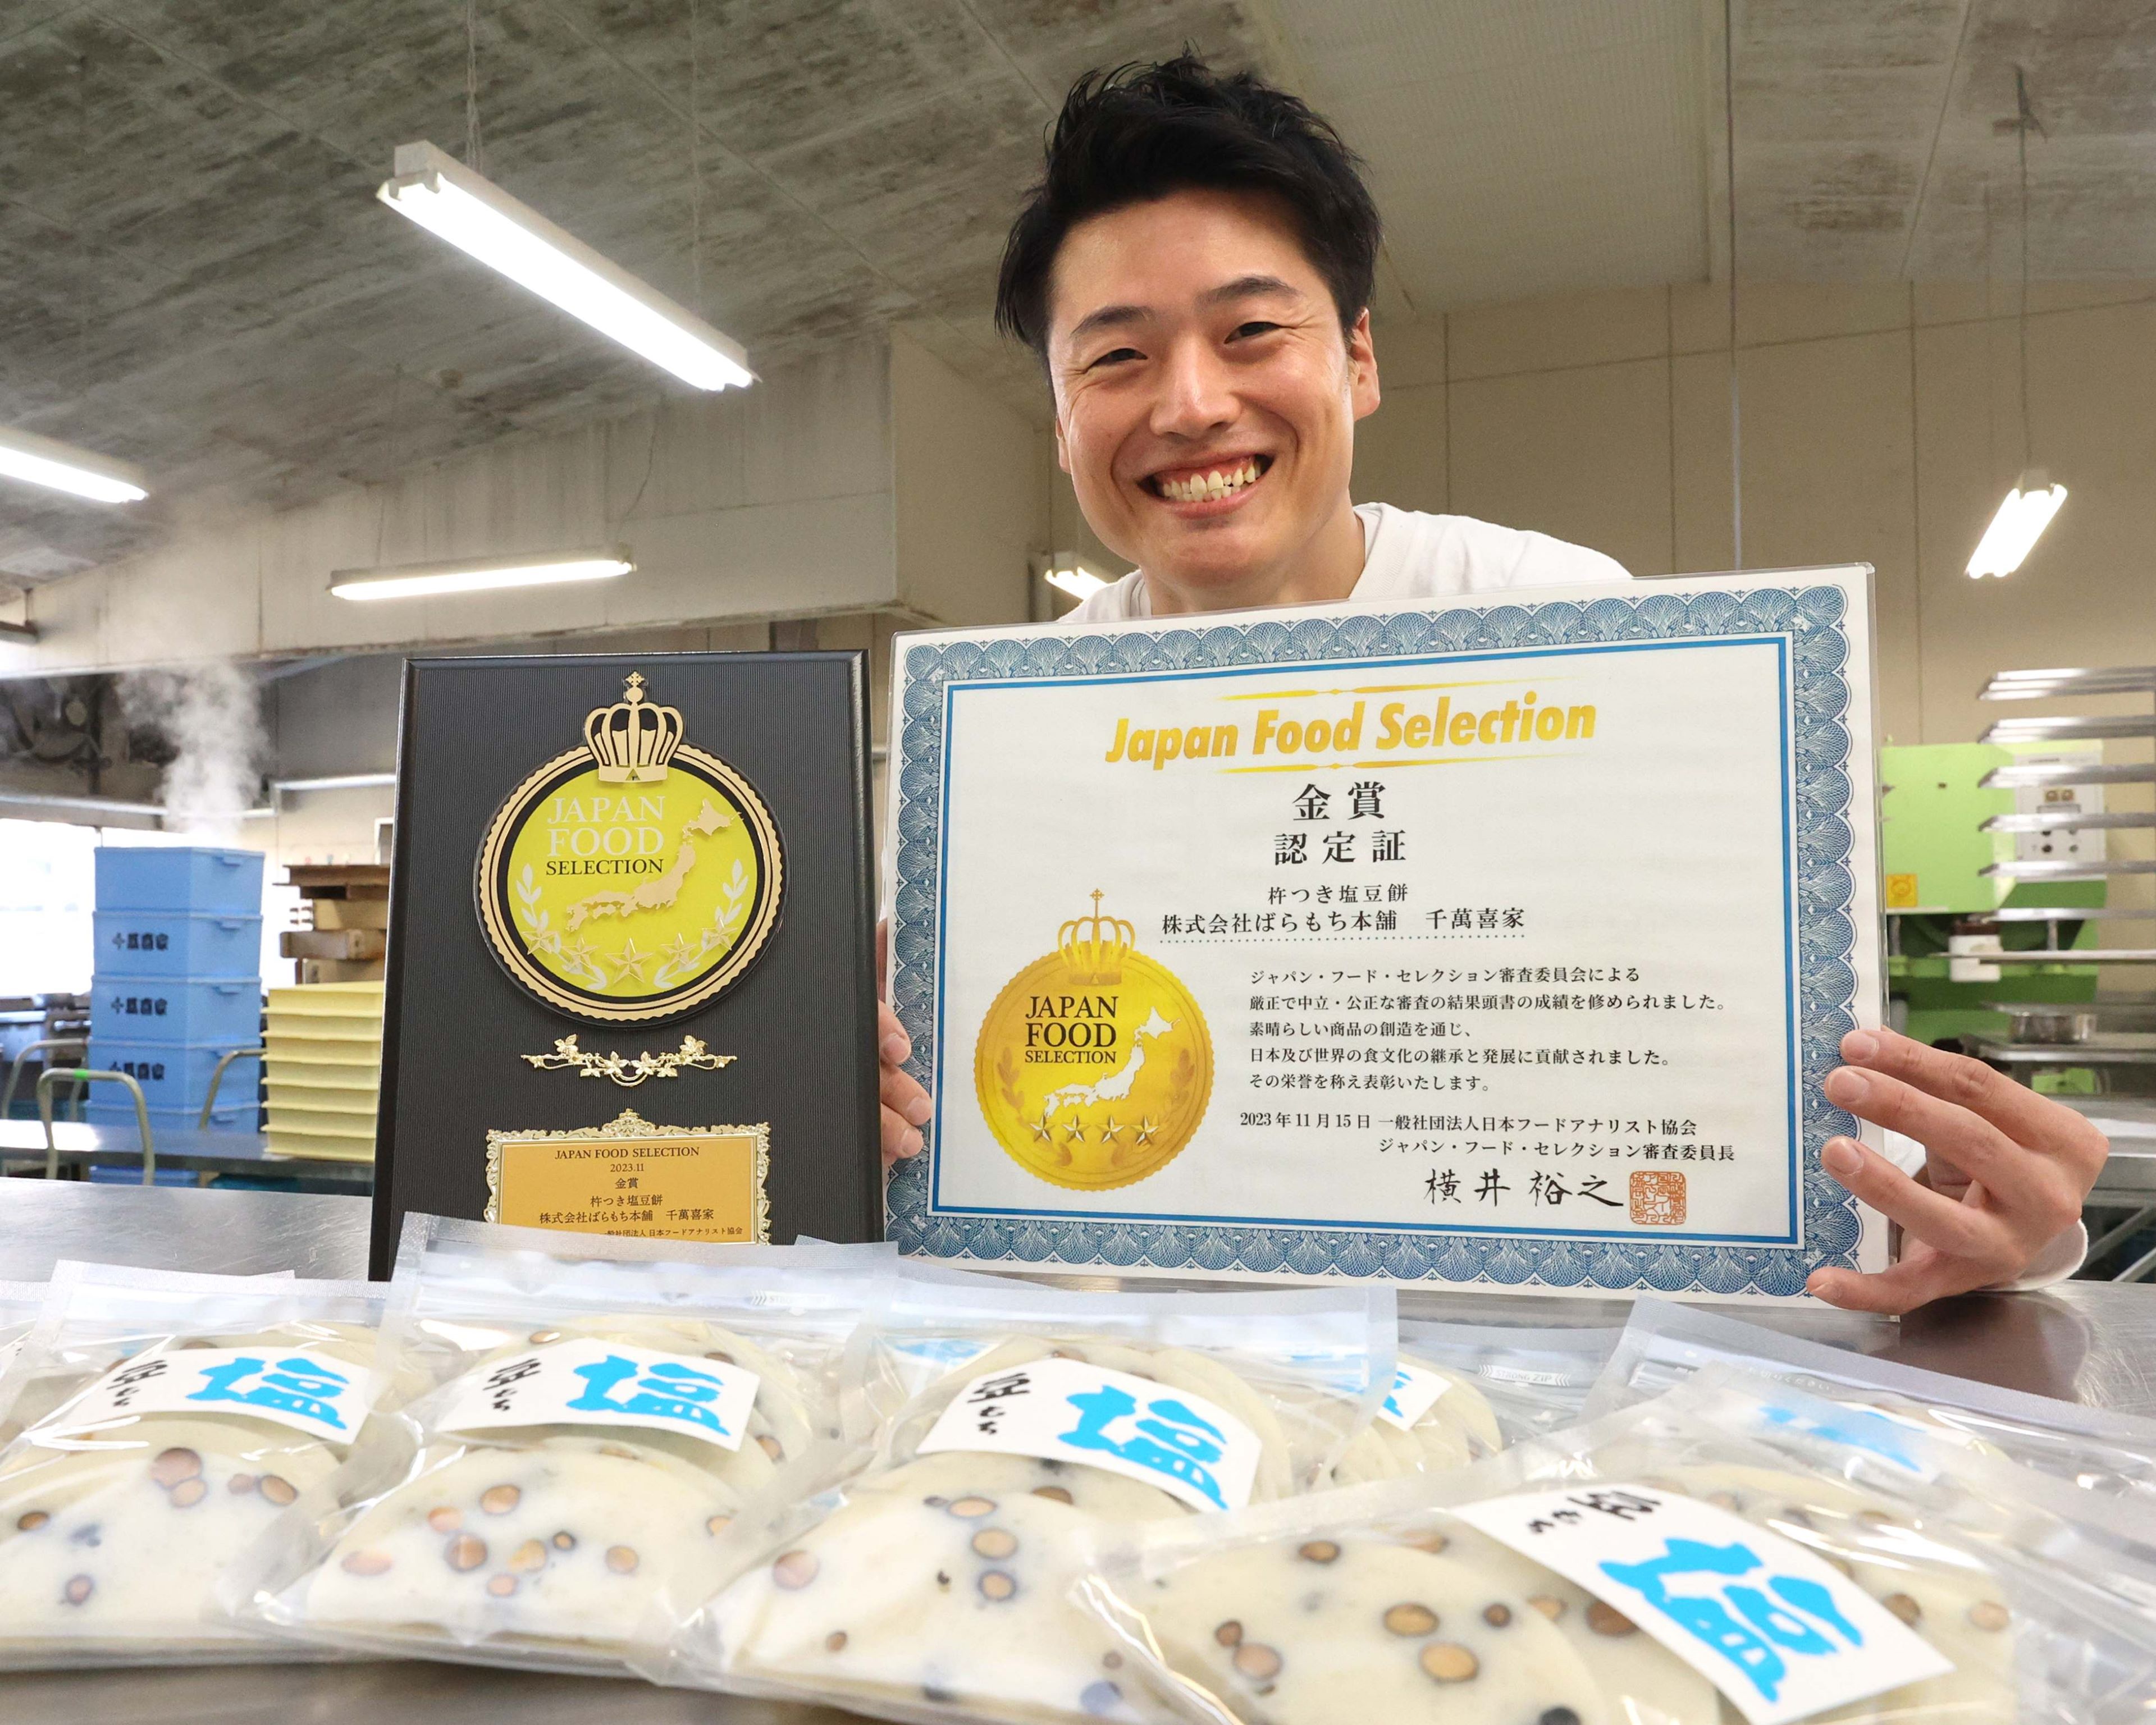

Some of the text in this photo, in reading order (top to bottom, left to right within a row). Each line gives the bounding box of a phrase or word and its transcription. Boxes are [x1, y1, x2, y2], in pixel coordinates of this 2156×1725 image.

[1105, 691, 1596, 770] Japan Food Selection
[547, 796, 666, 825] JAPAN
[1292, 781, 1387, 821] 金賞
[547, 827, 665, 857] FOOD
[1274, 830, 1407, 866] 認定証
[546, 859, 664, 876] SELECTION
[1267, 883, 1409, 906] 杵つき塩豆餅
[1162, 907, 1525, 936] 株式会社ばらもち本舗 千萬喜家
[1250, 966, 1641, 986] ジャパン・フード・セレクション審査委員会による
[1025, 996, 1118, 1019] JAPAN
[1025, 1022, 1117, 1048] FOOD
[1025, 1050, 1117, 1064] SELECTION
[1250, 1073, 1491, 1092] その栄誉を称え表彰いたします。
[555, 1147, 701, 1160] JAPAN FOOD SELECTION
[1379, 1138, 1735, 1161] ジャパン・フード・セレクション審査委員長
[610, 1163, 645, 1173] 2023.11
[615, 1177, 640, 1189] 金賞
[590, 1194, 664, 1208] 杵つき塩豆餅
[540, 1209, 654, 1224] 株式会社ばらもち本舗
[1533, 1374, 1552, 1382] ZIP
